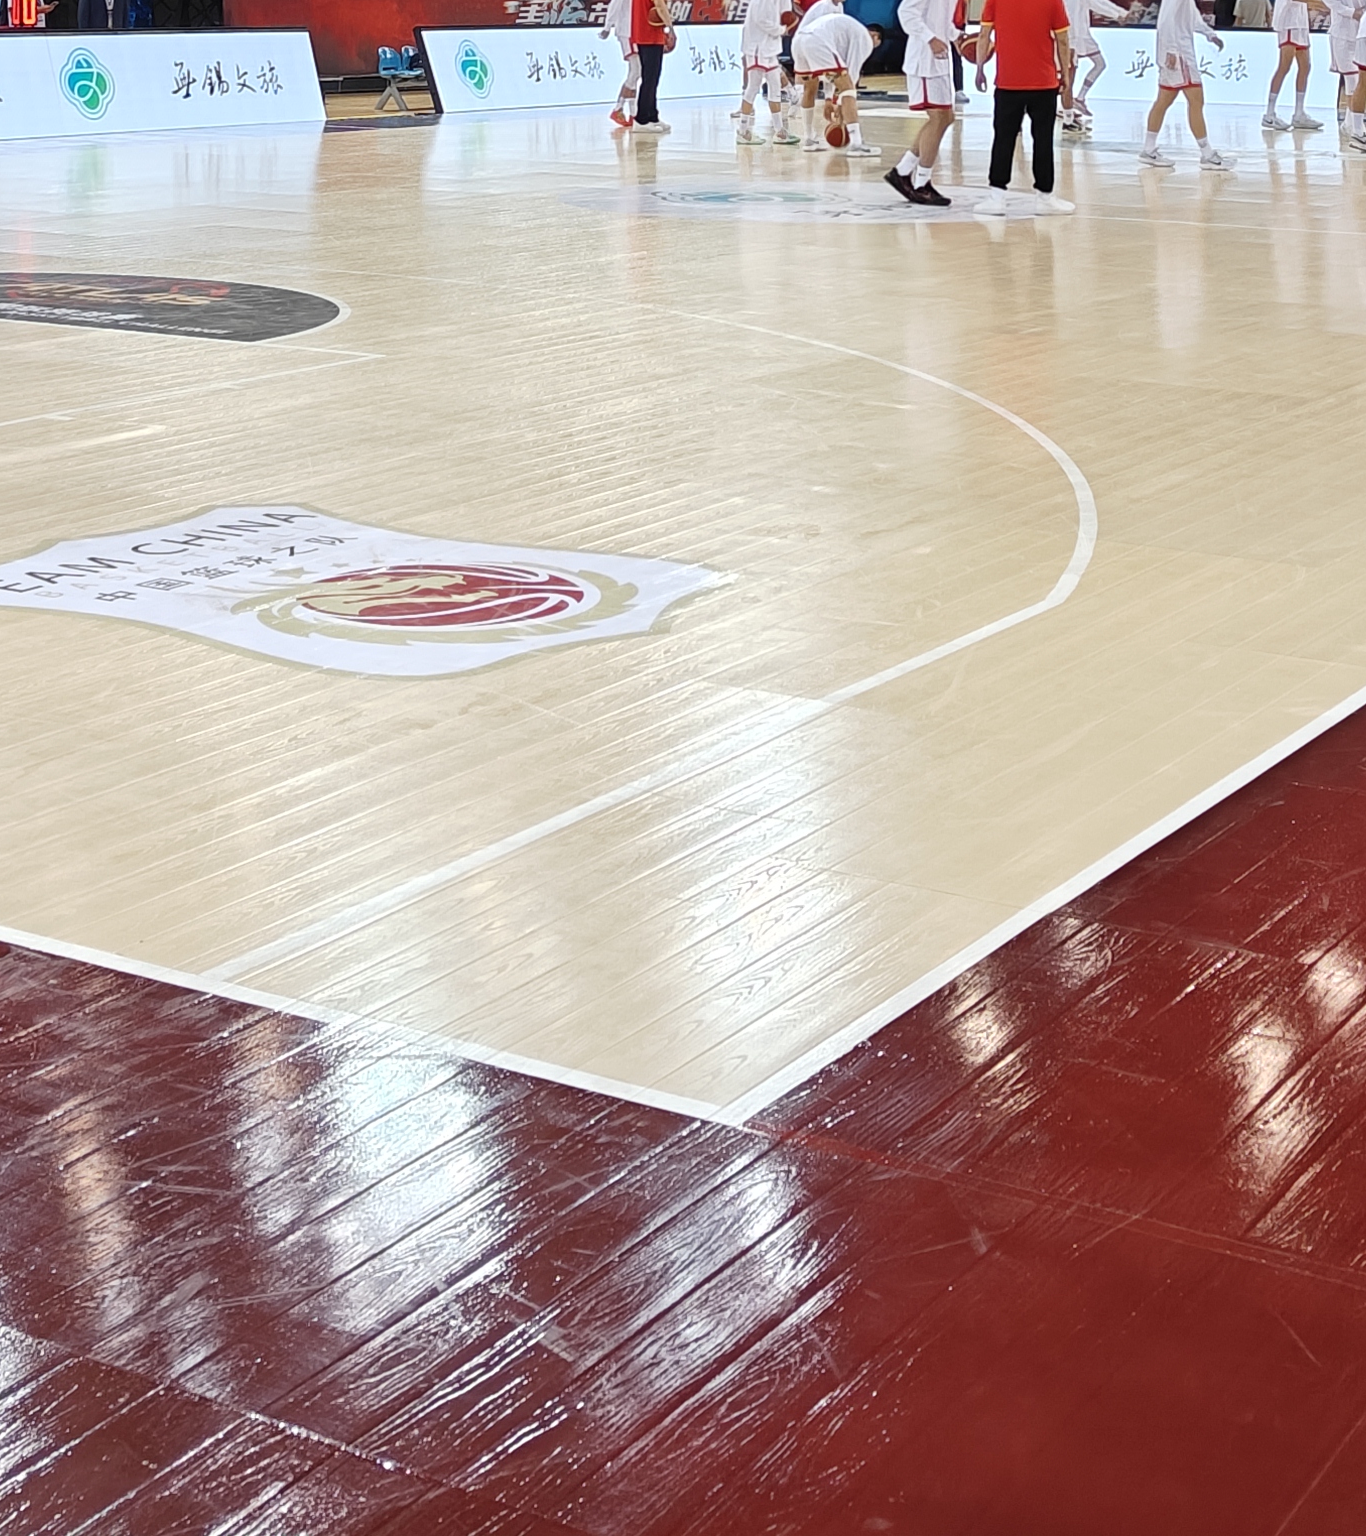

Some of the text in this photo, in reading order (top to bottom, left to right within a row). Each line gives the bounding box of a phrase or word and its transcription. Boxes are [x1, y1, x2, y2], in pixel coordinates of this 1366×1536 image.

[131, 511, 317, 556] CHINA
[94, 534, 360, 603] 中国篮球之队
